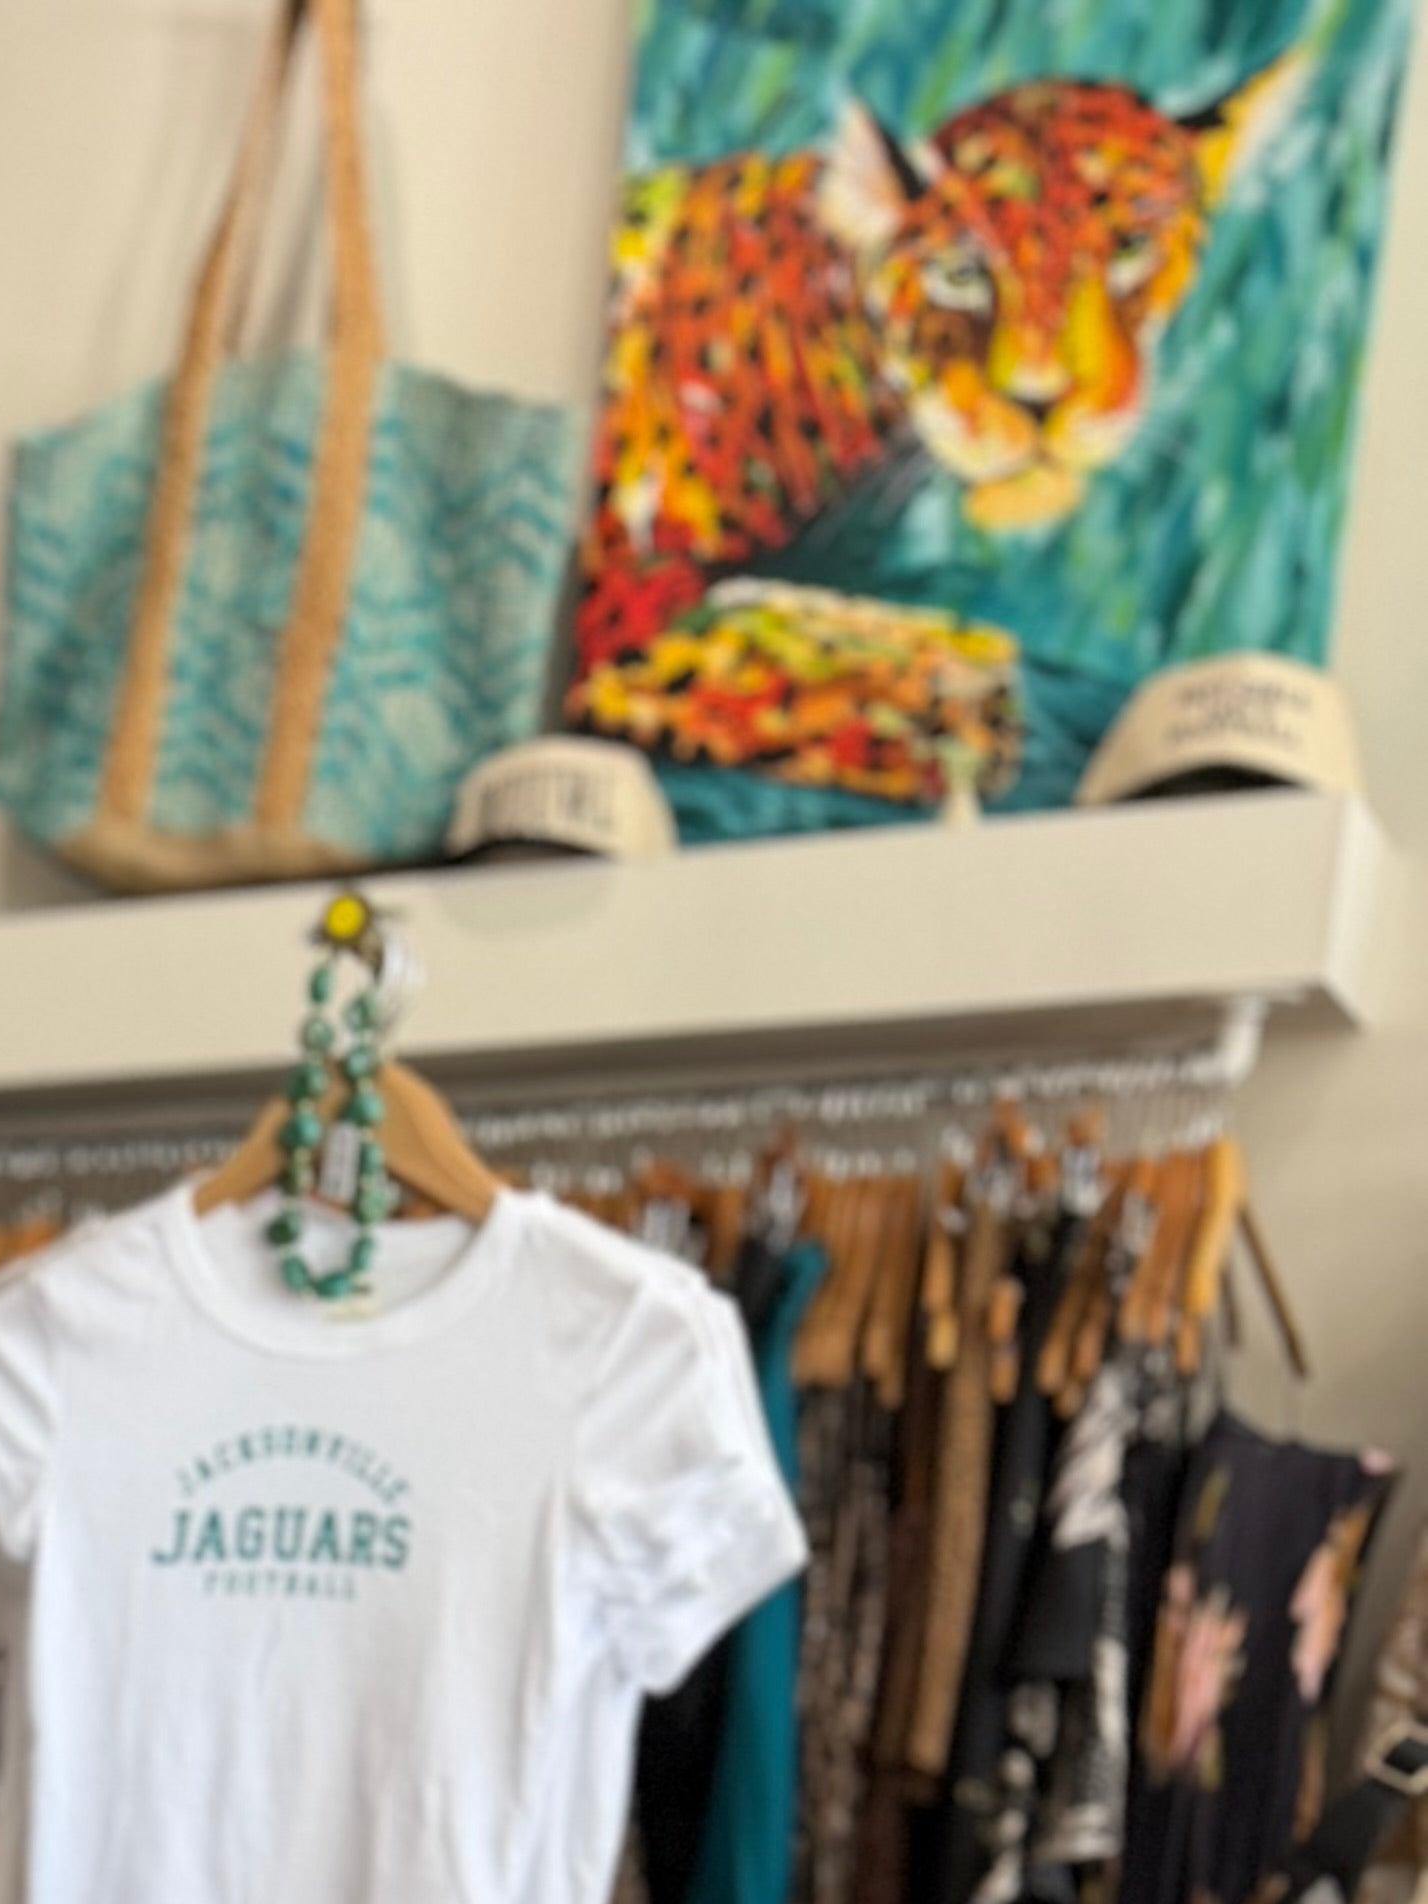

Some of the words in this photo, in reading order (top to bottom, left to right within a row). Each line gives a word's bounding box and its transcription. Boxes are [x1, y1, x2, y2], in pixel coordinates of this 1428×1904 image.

[175, 1423, 410, 1505] JACKSONVILLE
[153, 1507, 412, 1571] JAGUARS
[204, 1568, 357, 1600] FOOTBALL
